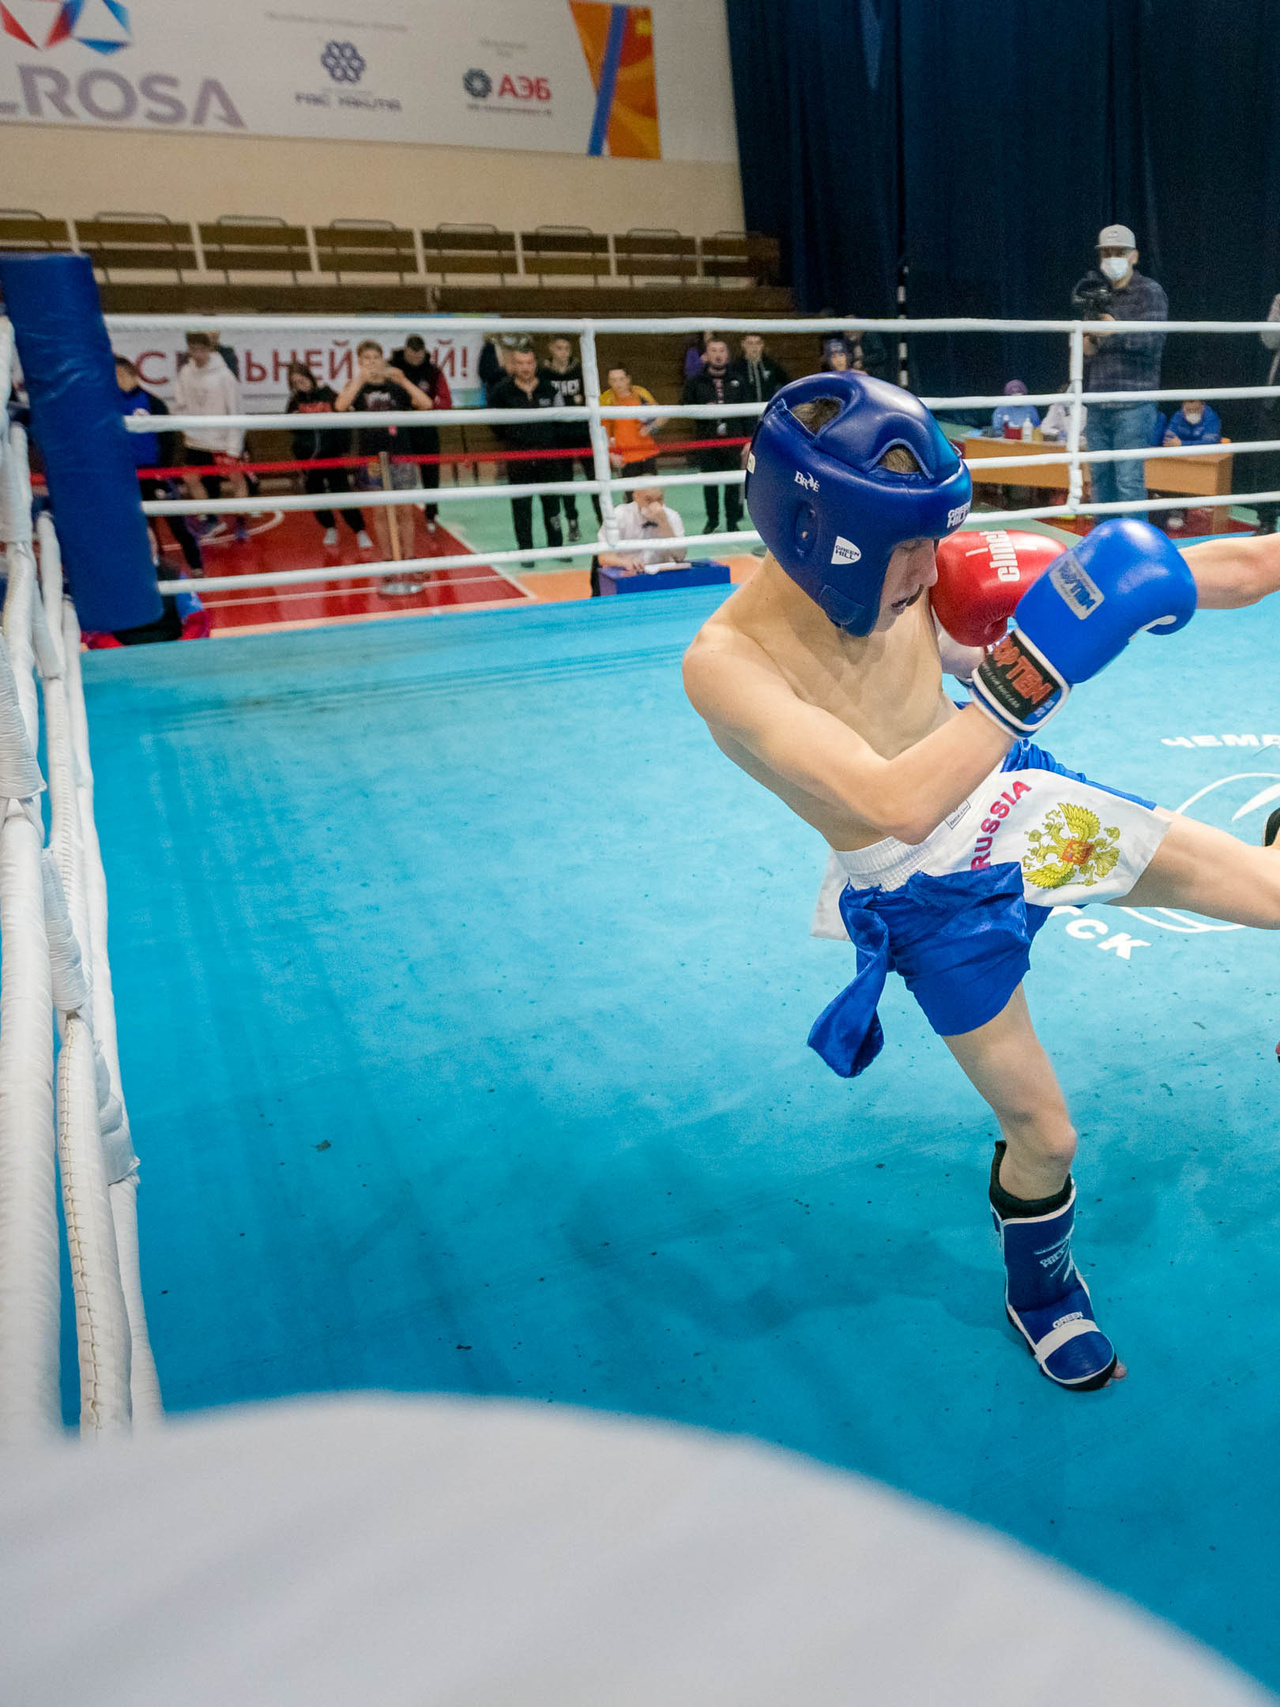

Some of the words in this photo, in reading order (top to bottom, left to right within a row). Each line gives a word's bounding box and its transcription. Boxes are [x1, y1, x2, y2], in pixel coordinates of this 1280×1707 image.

[498, 74, 552, 101] АЭБ
[835, 545, 860, 556] GREEN
[835, 550, 856, 561] HILL
[970, 780, 1032, 871] RUSSIA
